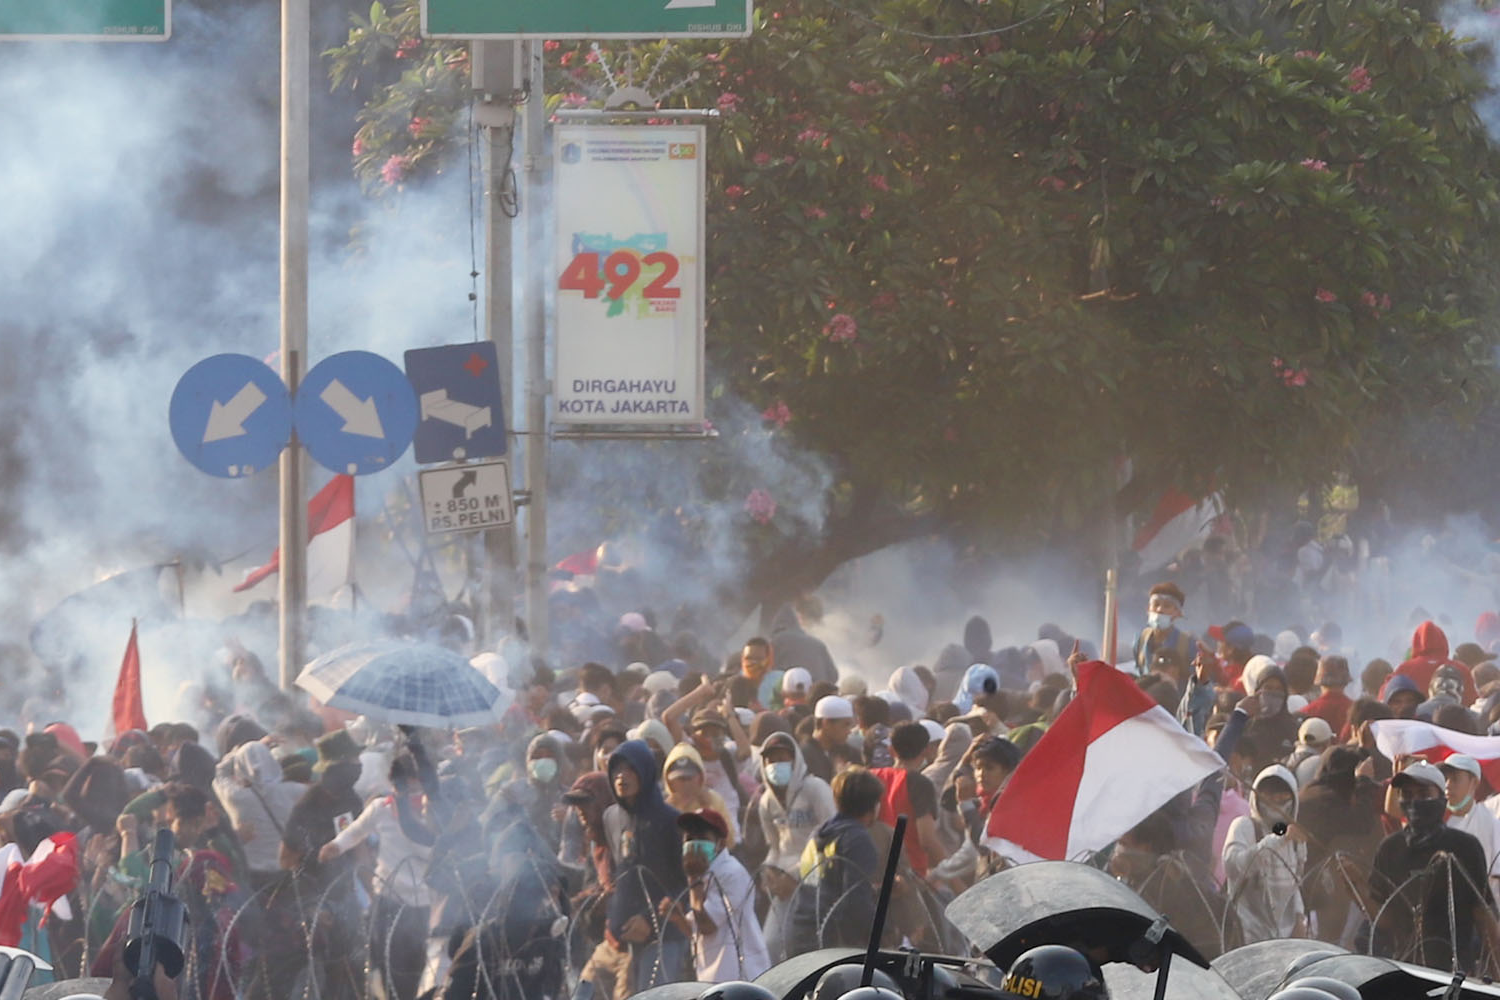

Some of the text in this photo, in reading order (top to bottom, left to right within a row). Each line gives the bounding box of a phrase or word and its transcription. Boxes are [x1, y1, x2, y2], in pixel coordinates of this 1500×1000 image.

[559, 251, 681, 299] 492
[573, 379, 676, 394] DIRGAHAYU
[559, 400, 690, 414] KOTA JAKARTA
[447, 497, 479, 512] 850
